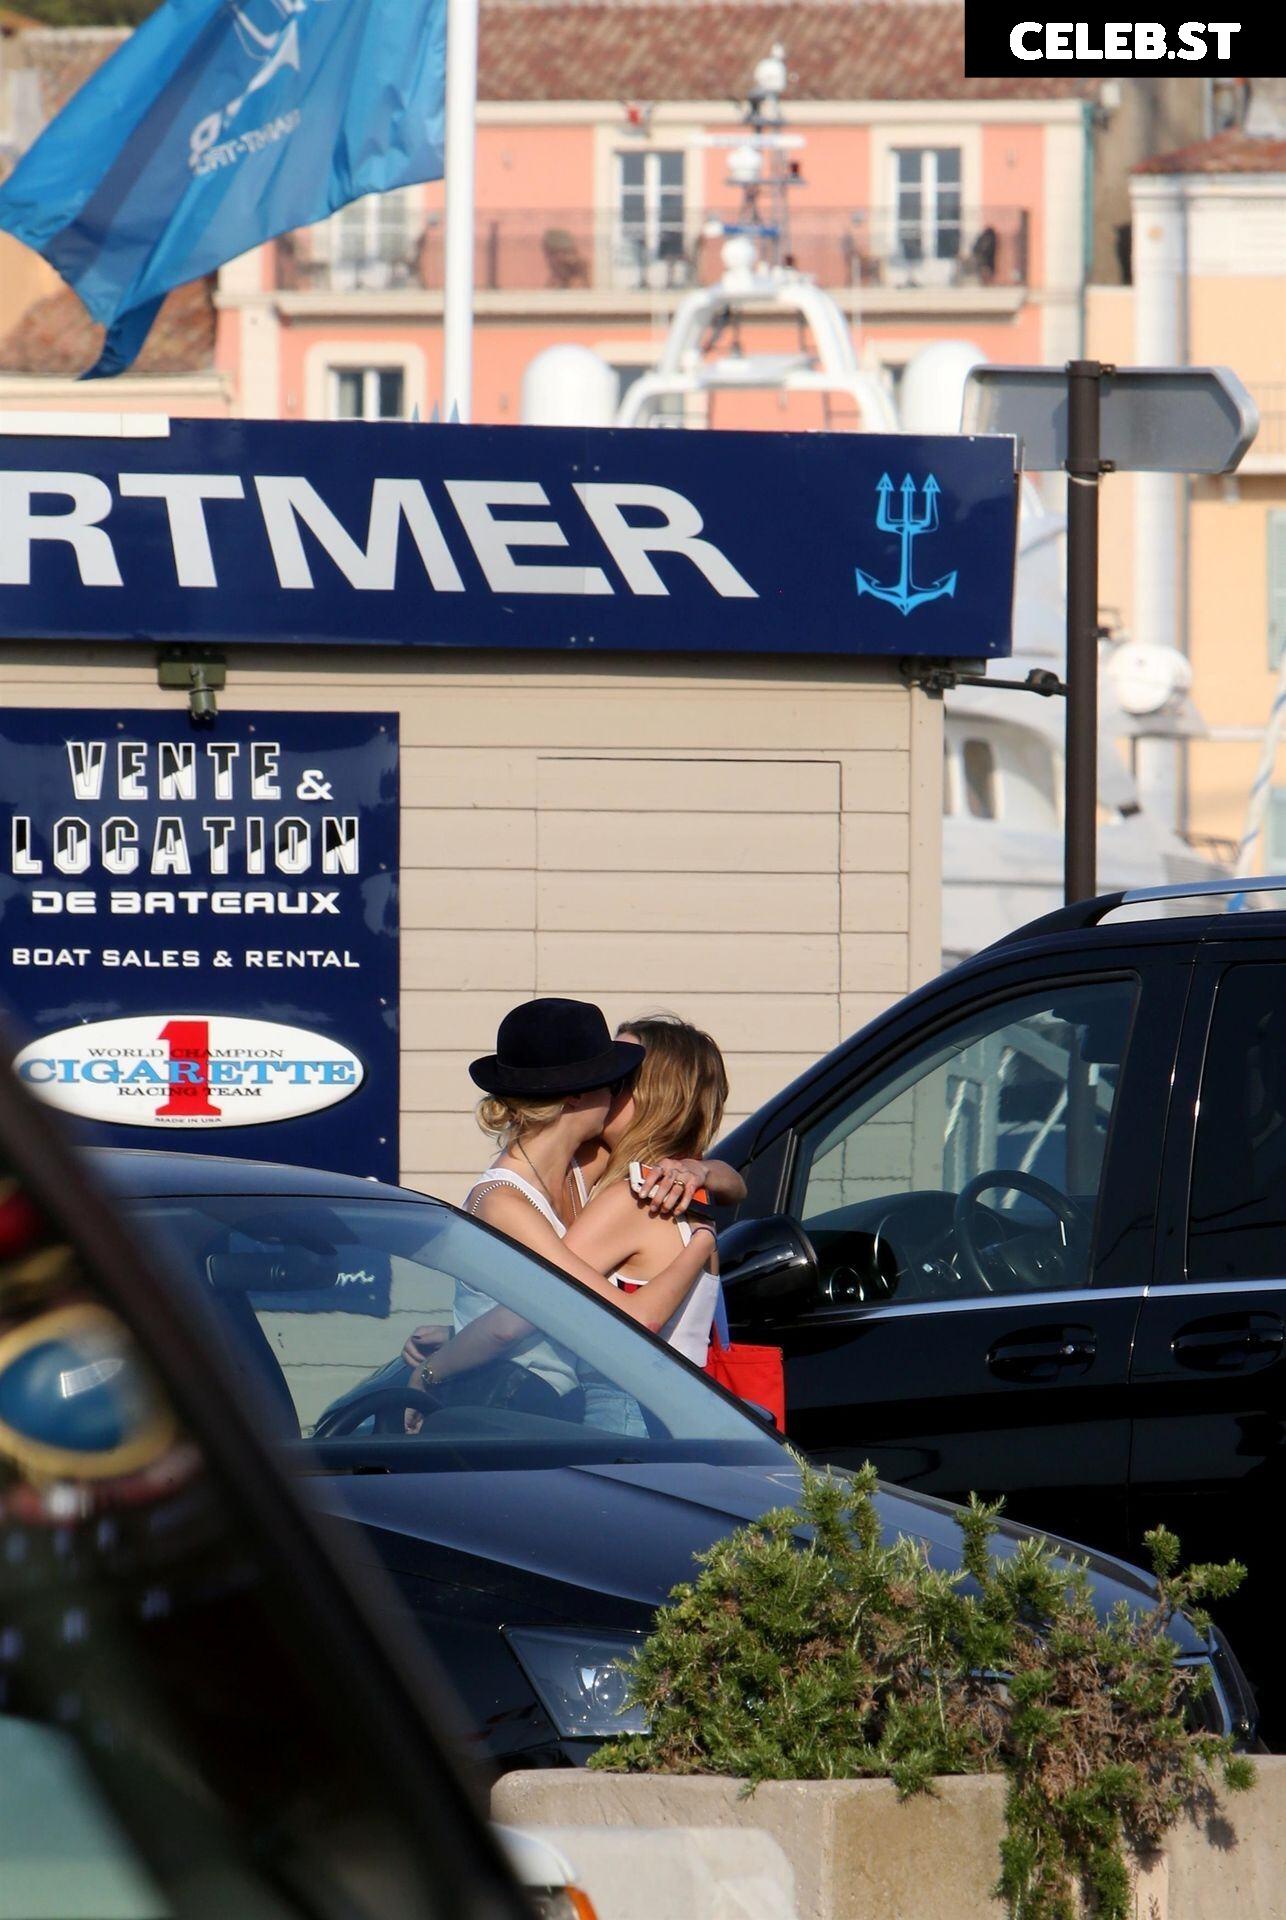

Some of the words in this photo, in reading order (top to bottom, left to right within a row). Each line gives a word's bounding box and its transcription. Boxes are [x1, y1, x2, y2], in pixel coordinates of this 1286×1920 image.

[0, 470, 760, 598] RTMER
[67, 741, 281, 800] VENTE
[296, 769, 333, 800] &
[12, 816, 359, 874] LOCATION
[32, 891, 97, 914] DE
[110, 891, 341, 914] BATEAUX
[12, 948, 91, 966] BOAT
[102, 949, 200, 968] SALES
[212, 951, 233, 968] &
[246, 950, 360, 968] RENTAL
[88, 1048, 164, 1058] WORLD
[170, 1049, 284, 1058] CHAMPION
[19, 1058, 356, 1085] CIGARETTE
[156, 1020, 222, 1116] 1
[118, 1086, 198, 1096] RACING
[207, 1087, 262, 1096] TEAM
